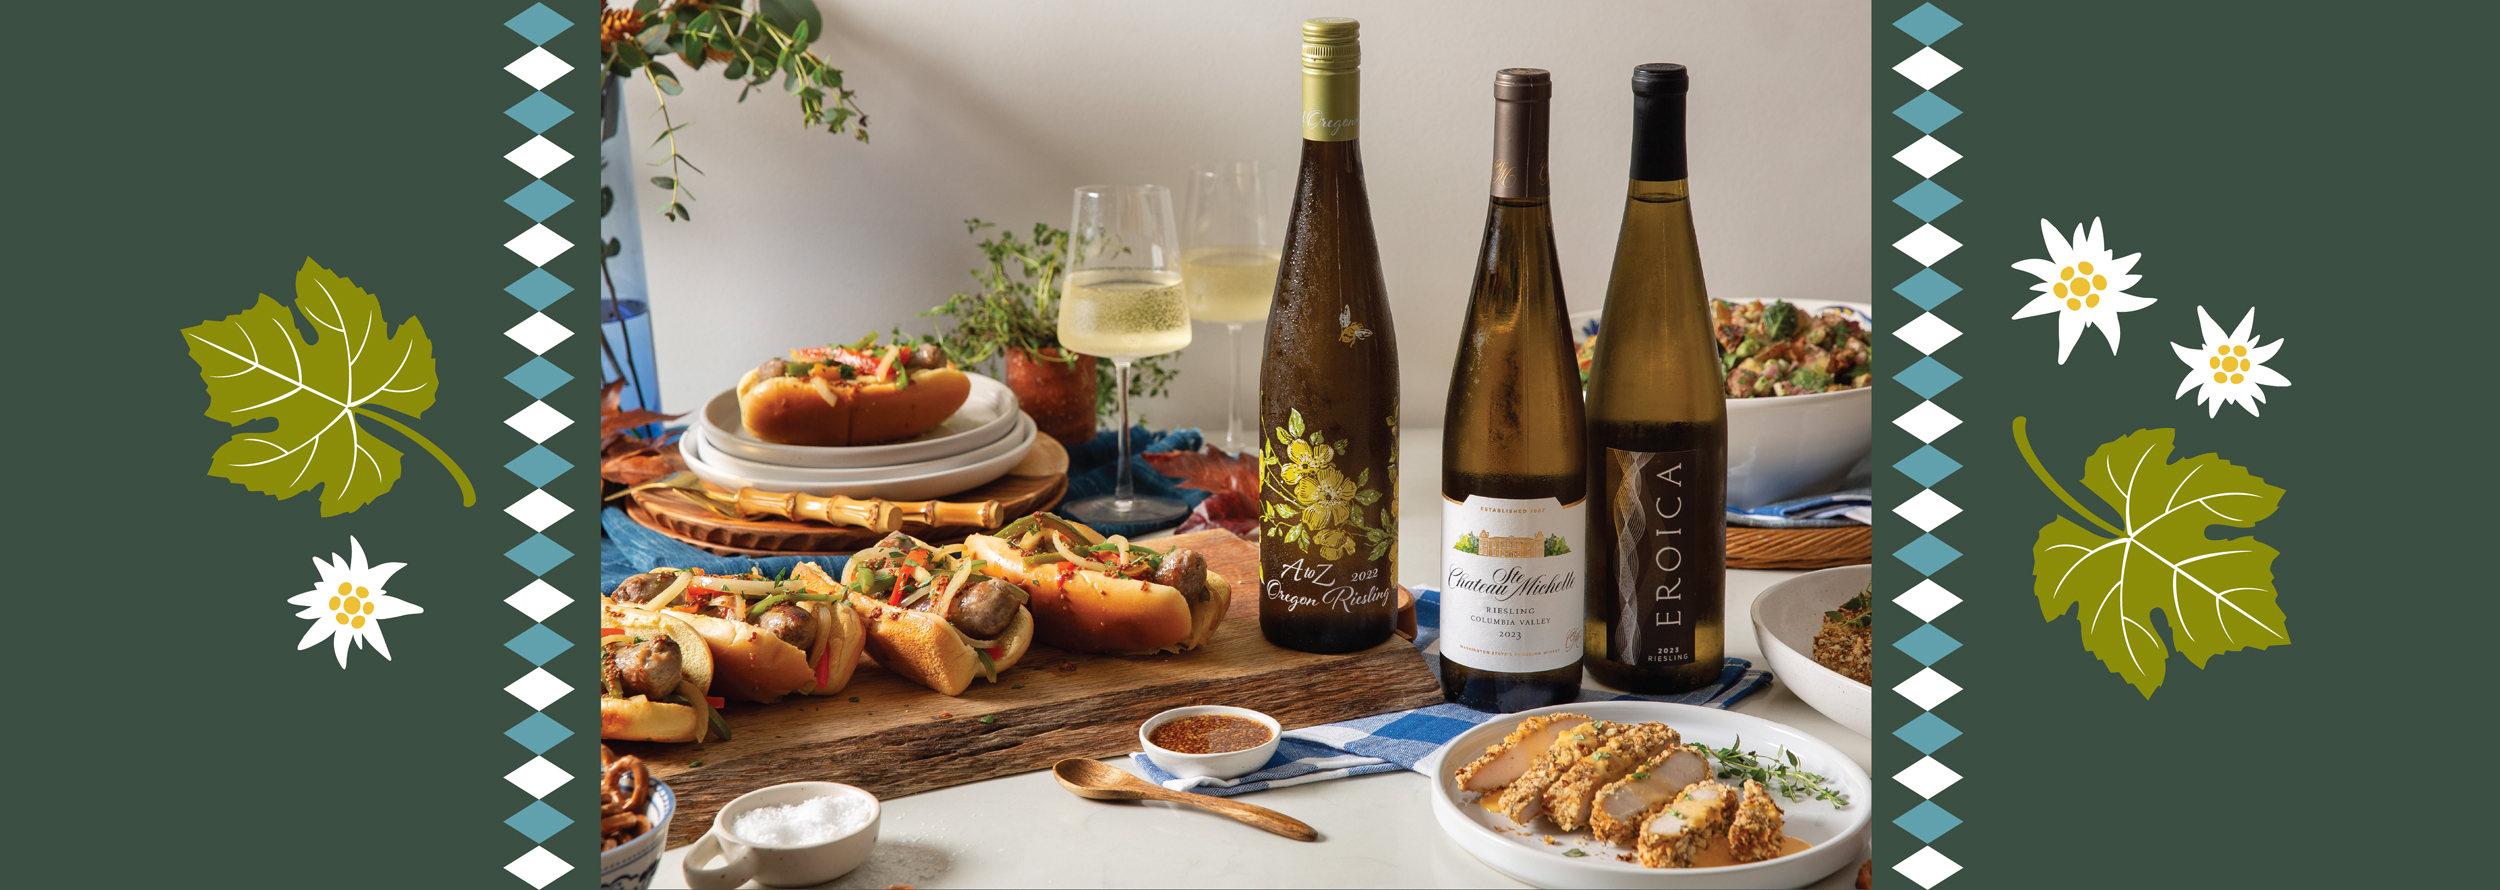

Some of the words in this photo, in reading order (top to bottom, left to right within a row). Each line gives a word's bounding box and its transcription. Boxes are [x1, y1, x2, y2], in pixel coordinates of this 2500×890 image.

[1306, 109, 1358, 136] Oregon
[1480, 506, 1528, 514] ESTABLISHED
[1655, 462, 1682, 626] EROICA
[1280, 558, 1304, 582] A
[1303, 566, 1316, 579] to
[1311, 563, 1336, 587] Z
[1351, 568, 1379, 582] 2022
[1447, 563, 1509, 596] Chateau
[1492, 565, 1525, 585] Ste
[1494, 570, 1576, 602] Michelle
[1266, 579, 1320, 613] Oregon
[1321, 585, 1391, 613] Riesling
[1486, 606, 1536, 615] RIESLING
[1470, 615, 1516, 626] COLUMBIA
[1519, 617, 1551, 626] VALLEY
[1499, 631, 1522, 640] 2023
[1647, 653, 1689, 662] RIESLING
[1657, 646, 1680, 655] 2023
